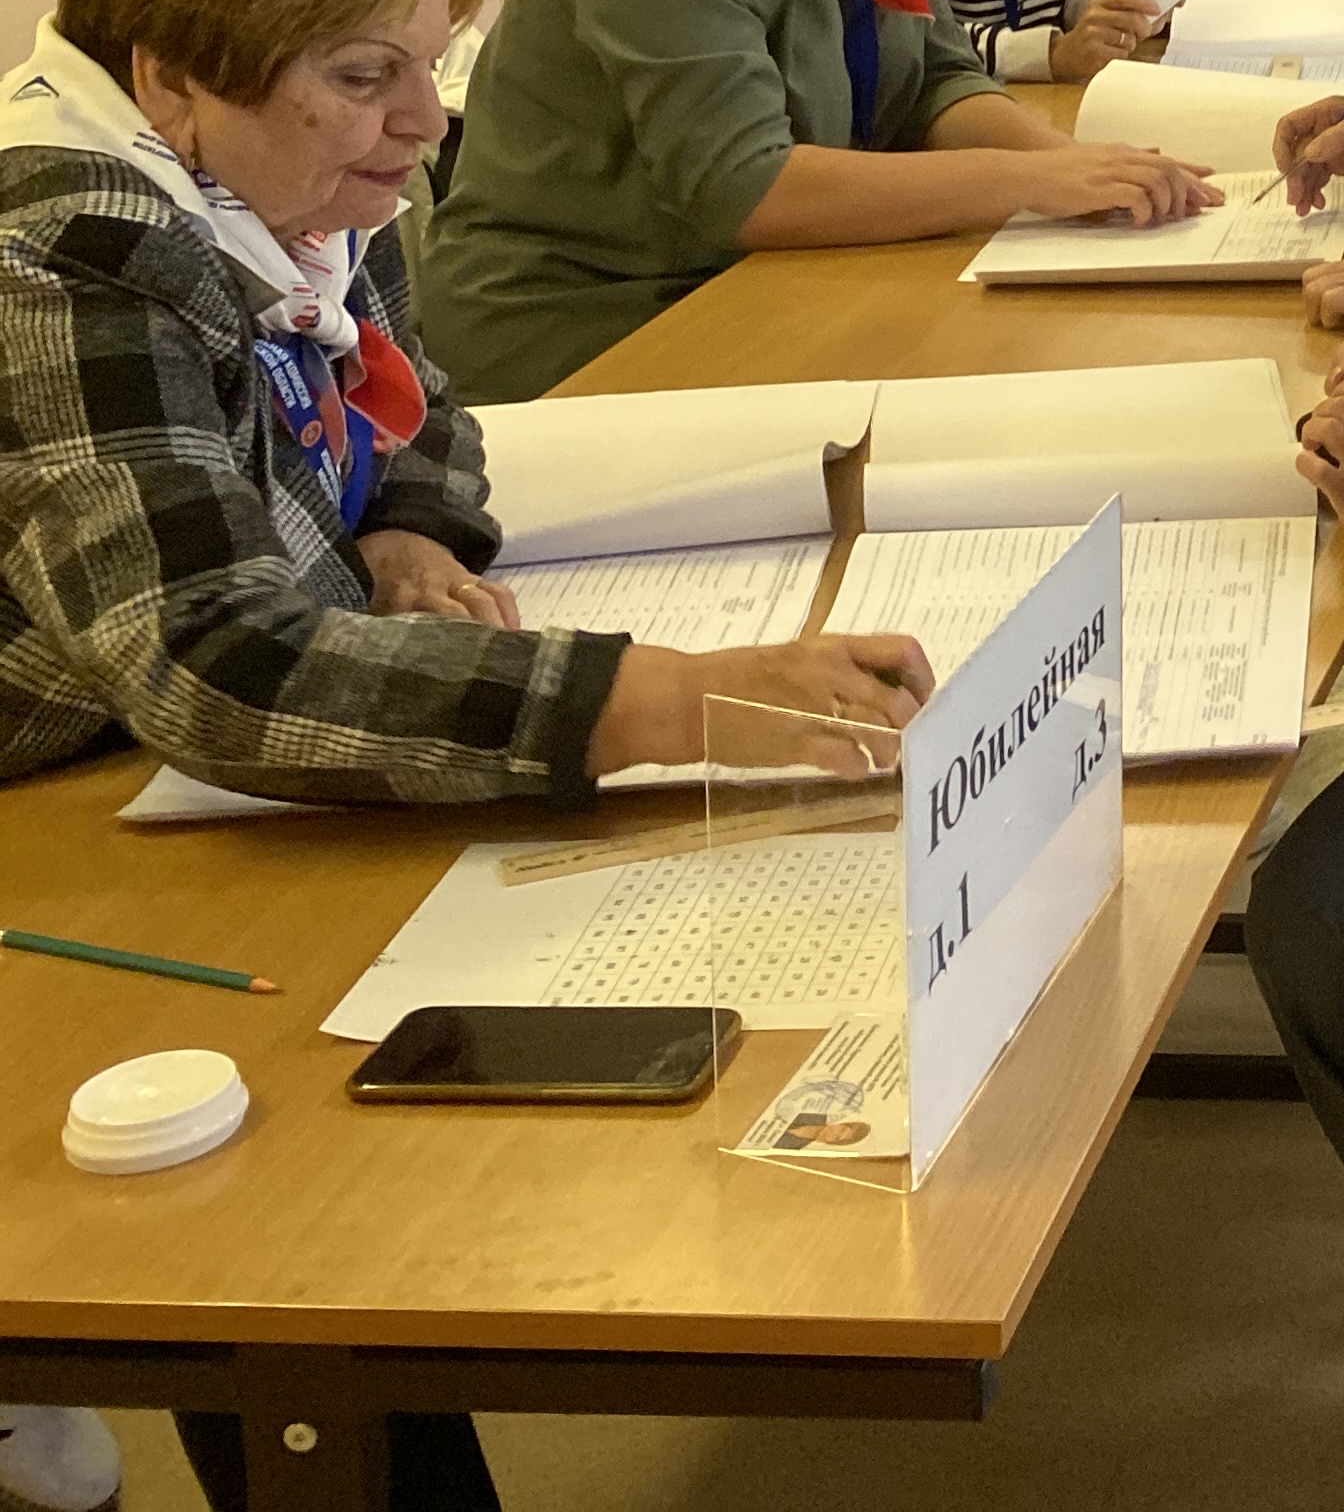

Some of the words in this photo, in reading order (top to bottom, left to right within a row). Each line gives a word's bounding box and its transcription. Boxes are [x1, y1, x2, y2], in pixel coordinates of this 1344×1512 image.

[284, 359, 313, 410] КОМИССИЯ
[927, 604, 1107, 858] Юбилейная
[1071, 698, 1108, 805] д.3
[928, 870, 973, 997] д.1
